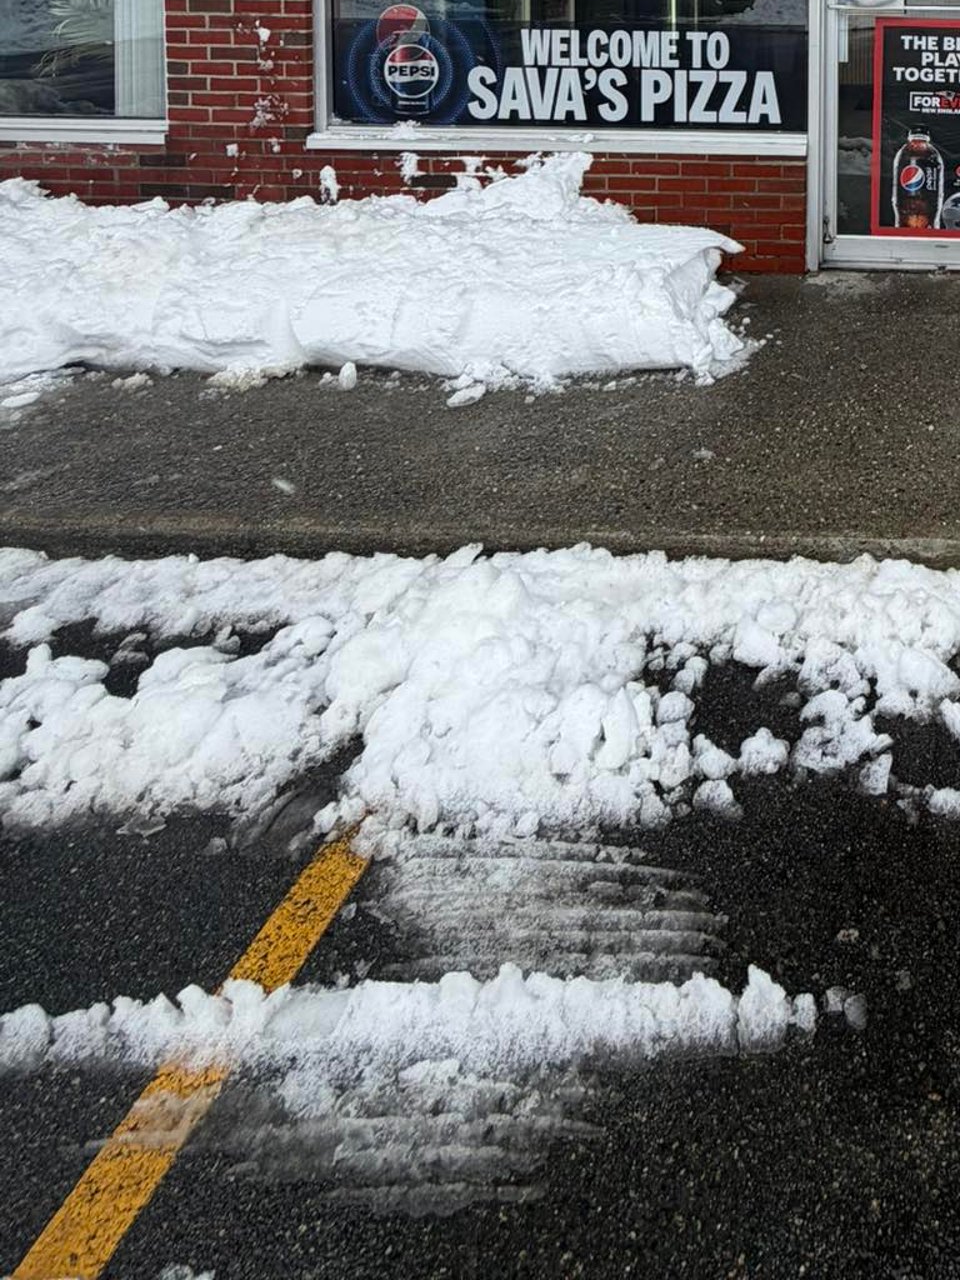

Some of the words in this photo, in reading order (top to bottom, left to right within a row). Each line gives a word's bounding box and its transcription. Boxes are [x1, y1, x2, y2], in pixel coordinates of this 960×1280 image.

[520, 28, 680, 68] WELCOME
[686, 31, 731, 70] TO
[900, 34, 939, 51] THE
[387, 66, 435, 78] PEPSI
[466, 64, 630, 122] SAVA'S
[640, 69, 783, 124] PIZZA
